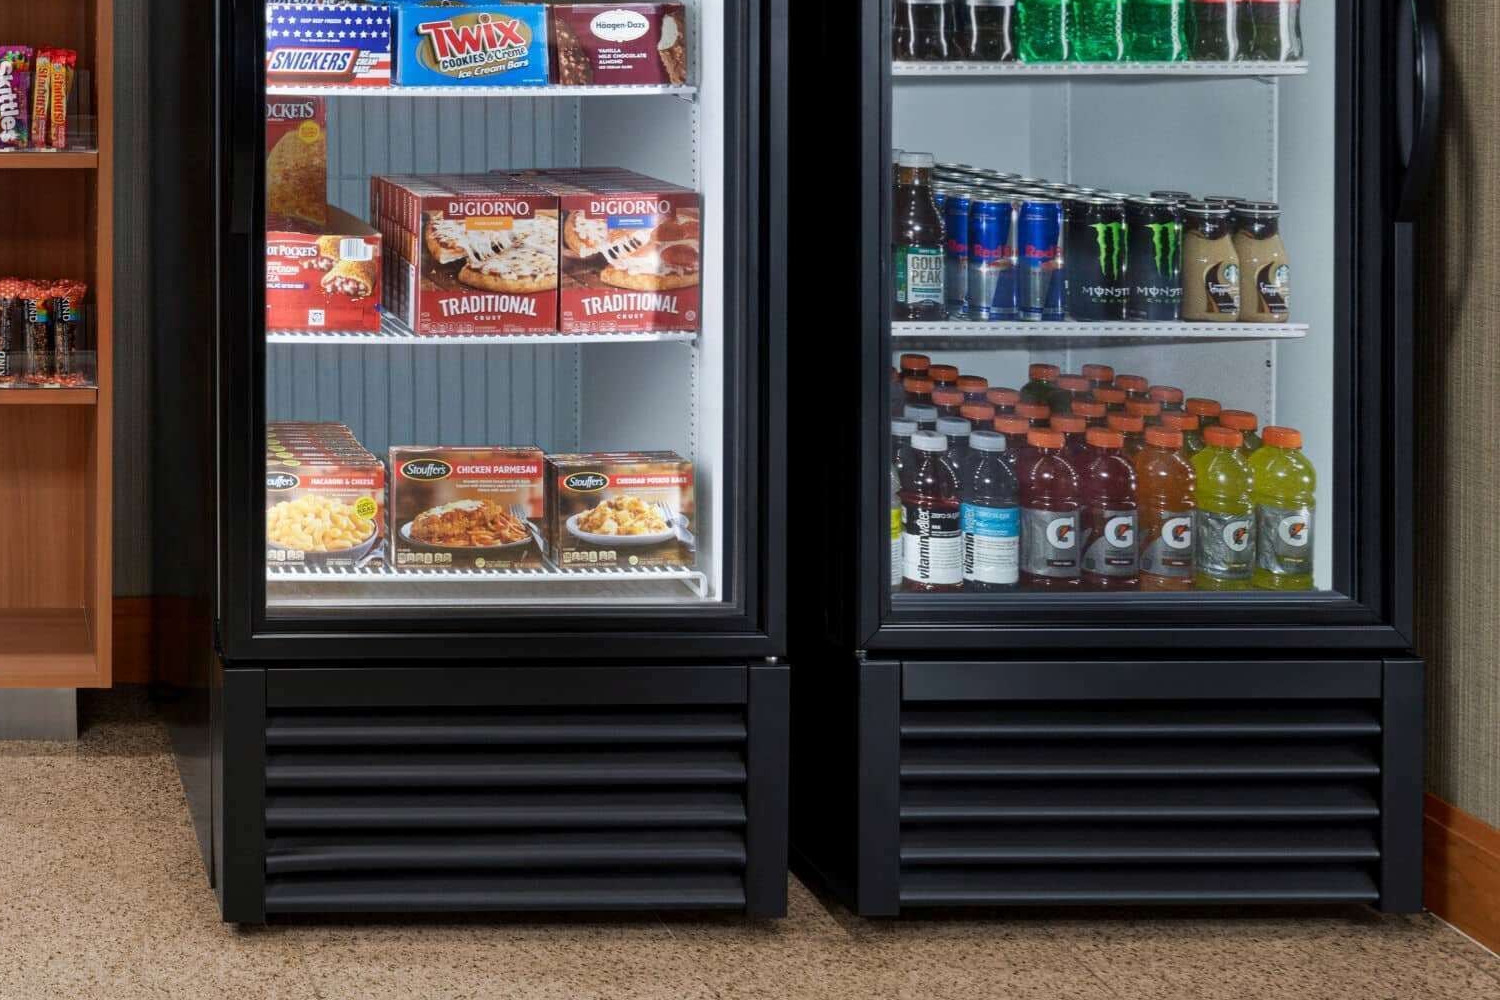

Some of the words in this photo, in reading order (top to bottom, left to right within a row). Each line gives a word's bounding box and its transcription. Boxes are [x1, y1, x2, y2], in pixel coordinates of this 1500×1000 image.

[272, 52, 350, 70] SNICKERS
[442, 54, 484, 71] COOKIES
[475, 64, 505, 74] Cream
[508, 59, 528, 68] Bars
[912, 256, 941, 270] GOLD
[912, 270, 941, 283] PEAK
[29, 300, 37, 322] KIND
[439, 294, 537, 317] TRADITIONAL
[581, 293, 679, 316] TRADITIONAL
[457, 464, 491, 474] CHICKEN
[1047, 517, 1075, 549] G
[1105, 516, 1133, 548] G
[1162, 517, 1191, 549] G
[1223, 520, 1249, 551] G
[1278, 516, 1308, 547] G
